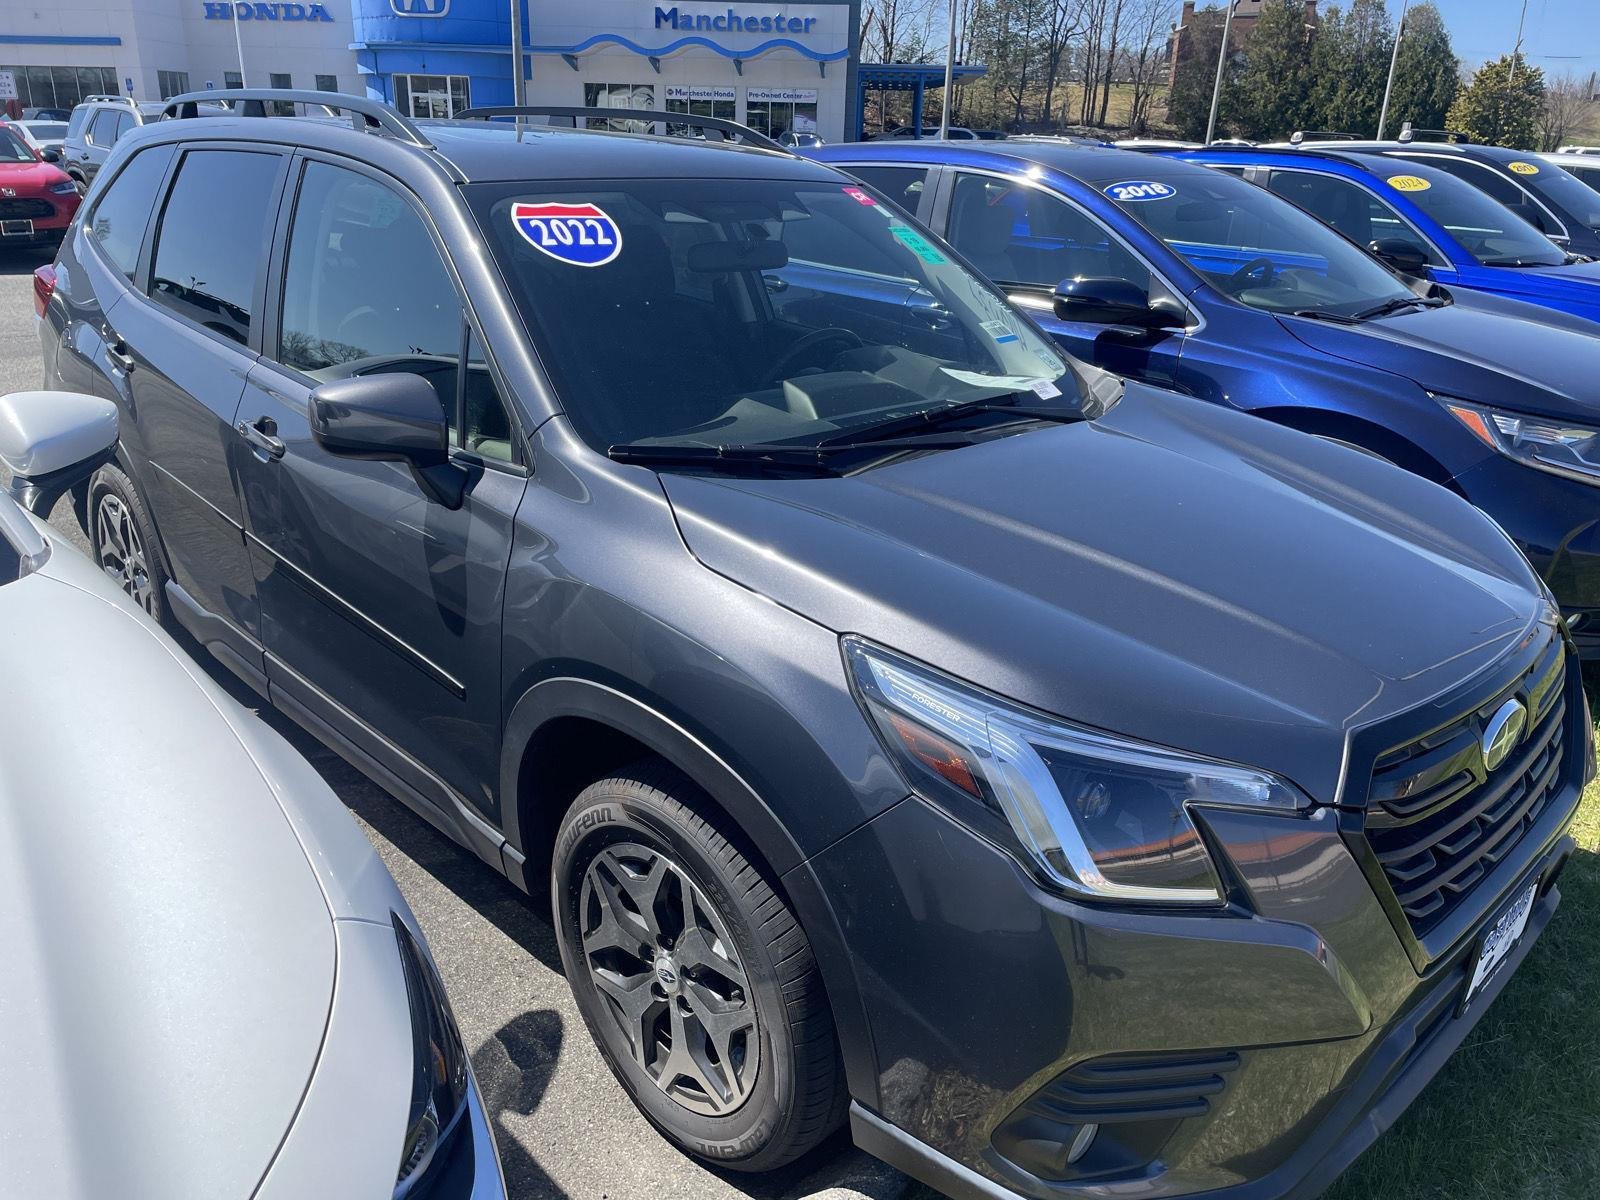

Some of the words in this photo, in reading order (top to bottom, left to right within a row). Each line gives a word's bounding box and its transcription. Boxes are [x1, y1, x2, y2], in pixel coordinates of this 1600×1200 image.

[203, 2, 335, 22] HONDA
[654, 6, 817, 34] Manchester
[713, 90, 735, 98] Honda
[1112, 182, 1169, 199] 2018
[529, 218, 613, 246] 2022
[911, 693, 961, 722] FORESTER
